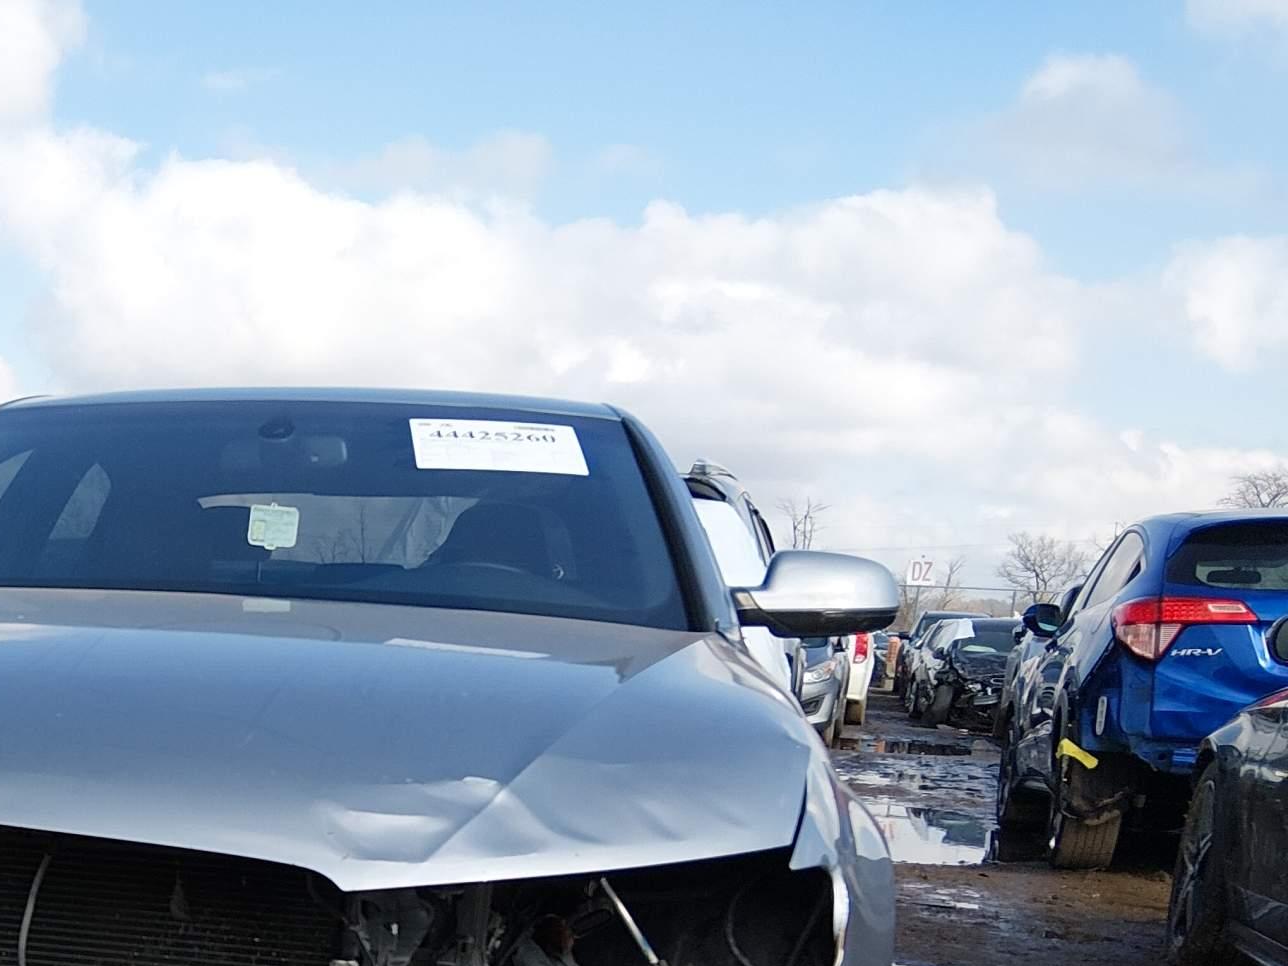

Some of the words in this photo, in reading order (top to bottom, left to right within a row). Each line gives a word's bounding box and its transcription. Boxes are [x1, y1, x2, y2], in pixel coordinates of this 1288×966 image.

[429, 430, 556, 443] 44425260
[911, 561, 933, 581] DZ
[1170, 648, 1223, 657] HR-V
